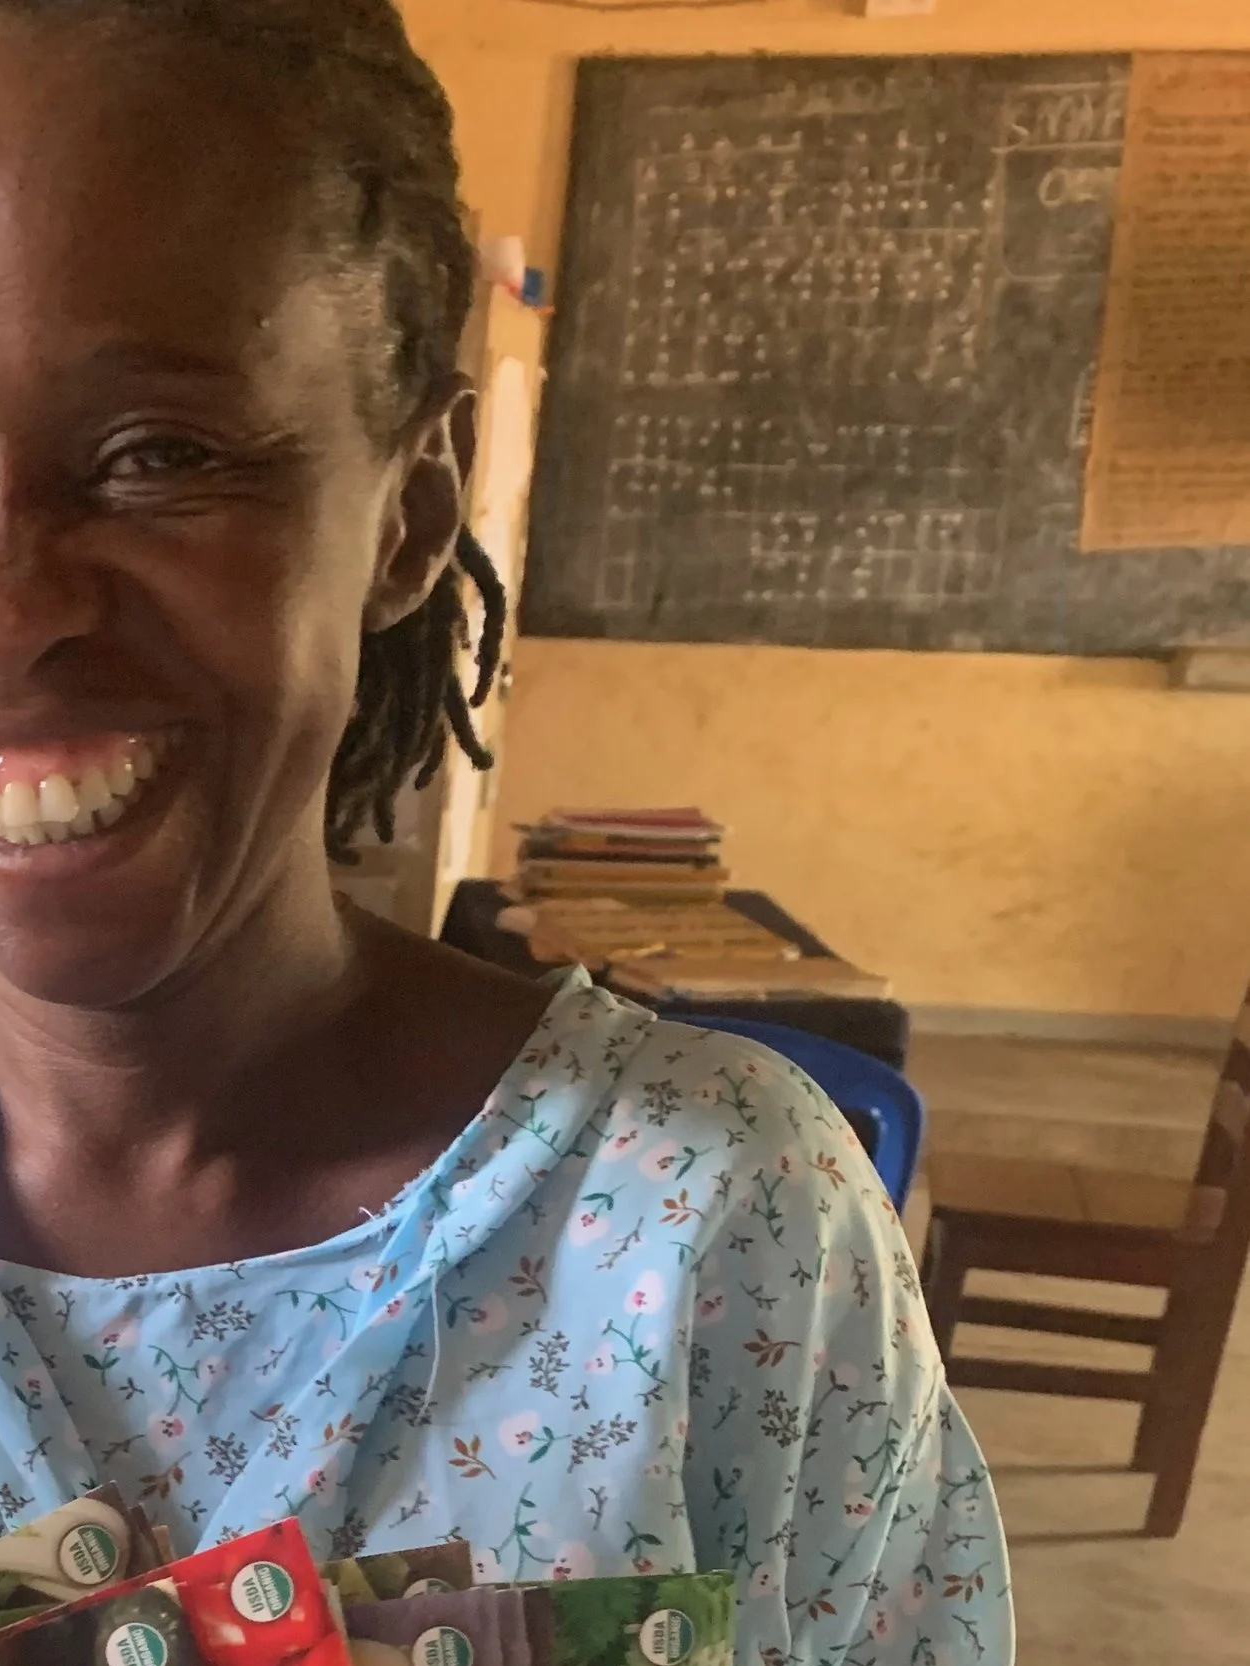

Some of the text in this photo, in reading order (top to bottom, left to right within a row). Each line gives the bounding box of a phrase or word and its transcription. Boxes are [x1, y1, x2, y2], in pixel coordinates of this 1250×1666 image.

[69, 1541, 93, 1576] USDA
[241, 1577, 265, 1613] USDA
[261, 1567, 283, 1611] ORGANIC
[653, 1620, 666, 1654] USDA
